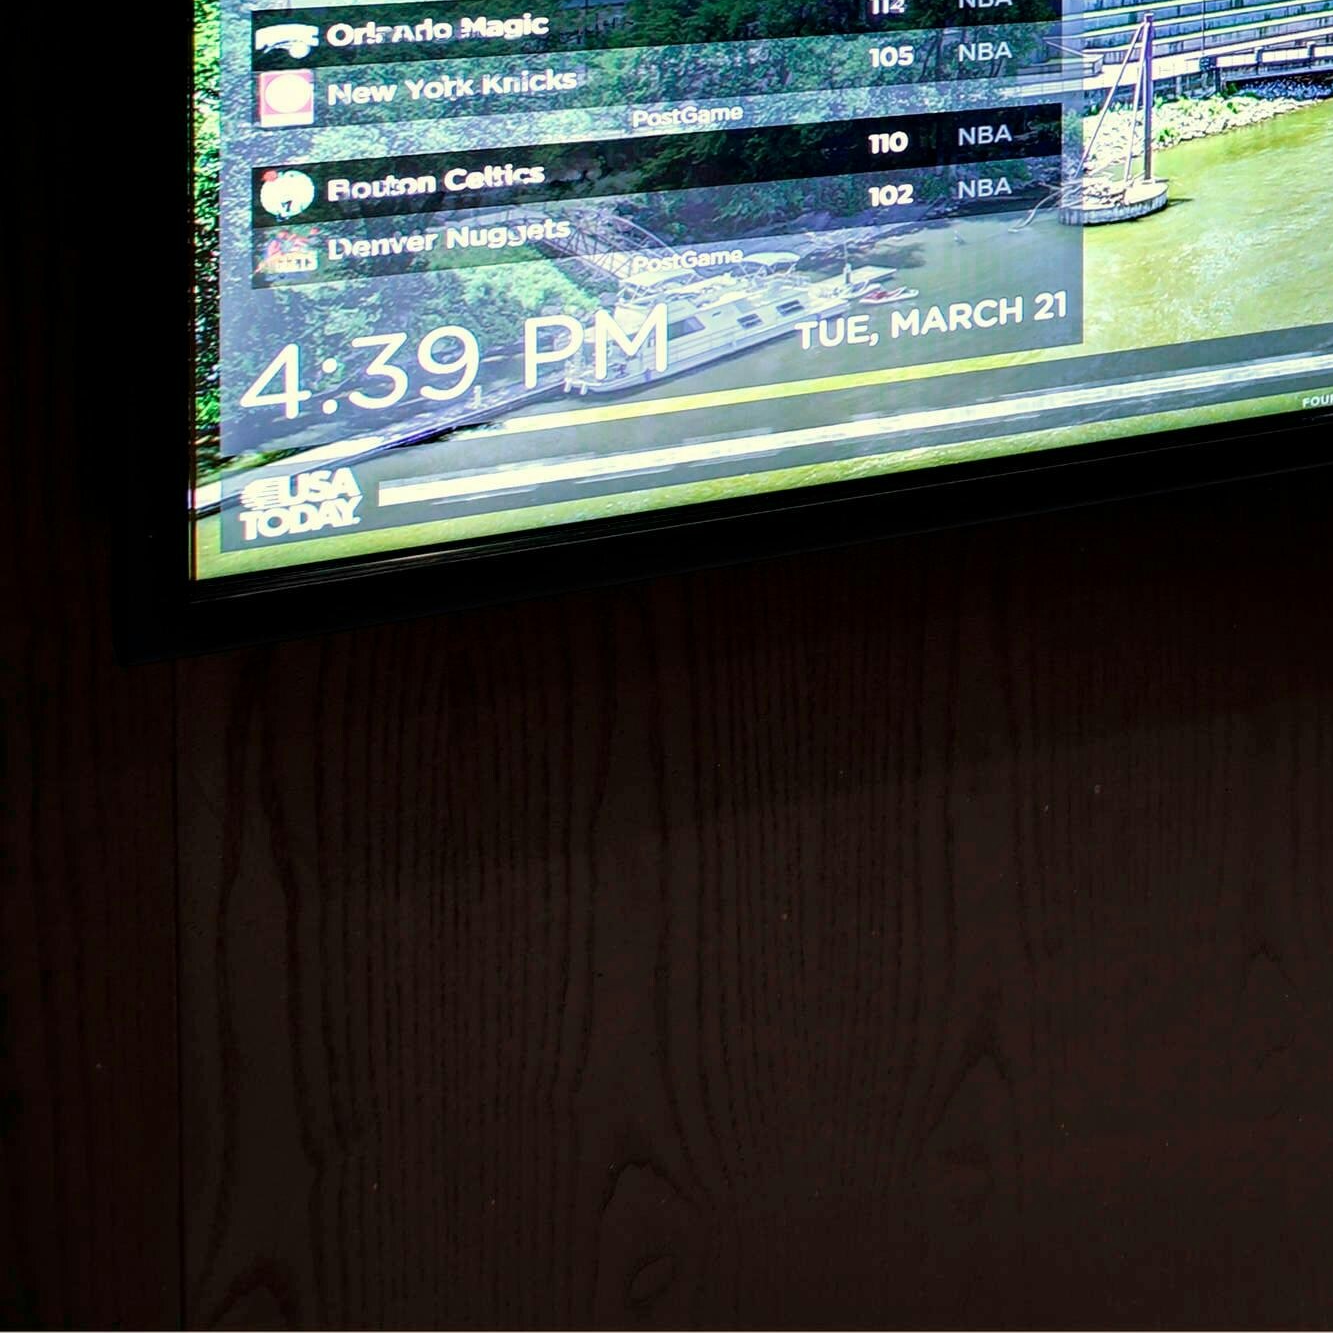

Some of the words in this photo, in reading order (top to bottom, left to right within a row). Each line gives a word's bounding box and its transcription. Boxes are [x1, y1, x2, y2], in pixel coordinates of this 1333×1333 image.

[459, 12, 550, 42] Magic
[868, 45, 915, 68] 105
[958, 41, 1013, 63] NBA
[327, 80, 398, 107] New
[404, 76, 475, 102] York
[481, 69, 578, 96] Knicks
[632, 104, 744, 129] PostGame
[867, 131, 909, 154] 110
[957, 125, 1013, 147] NBA
[868, 183, 915, 208] 102
[957, 177, 1013, 200] NBA
[327, 232, 439, 261] Denver
[446, 216, 572, 251] Nuggets
[794, 314, 880, 350] TUE,
[890, 296, 1023, 340] MARCH
[1033, 290, 1068, 322] 21
[240, 324, 481, 420] 4:39
[523, 303, 668, 389] PM
[280, 467, 361, 507] USA
